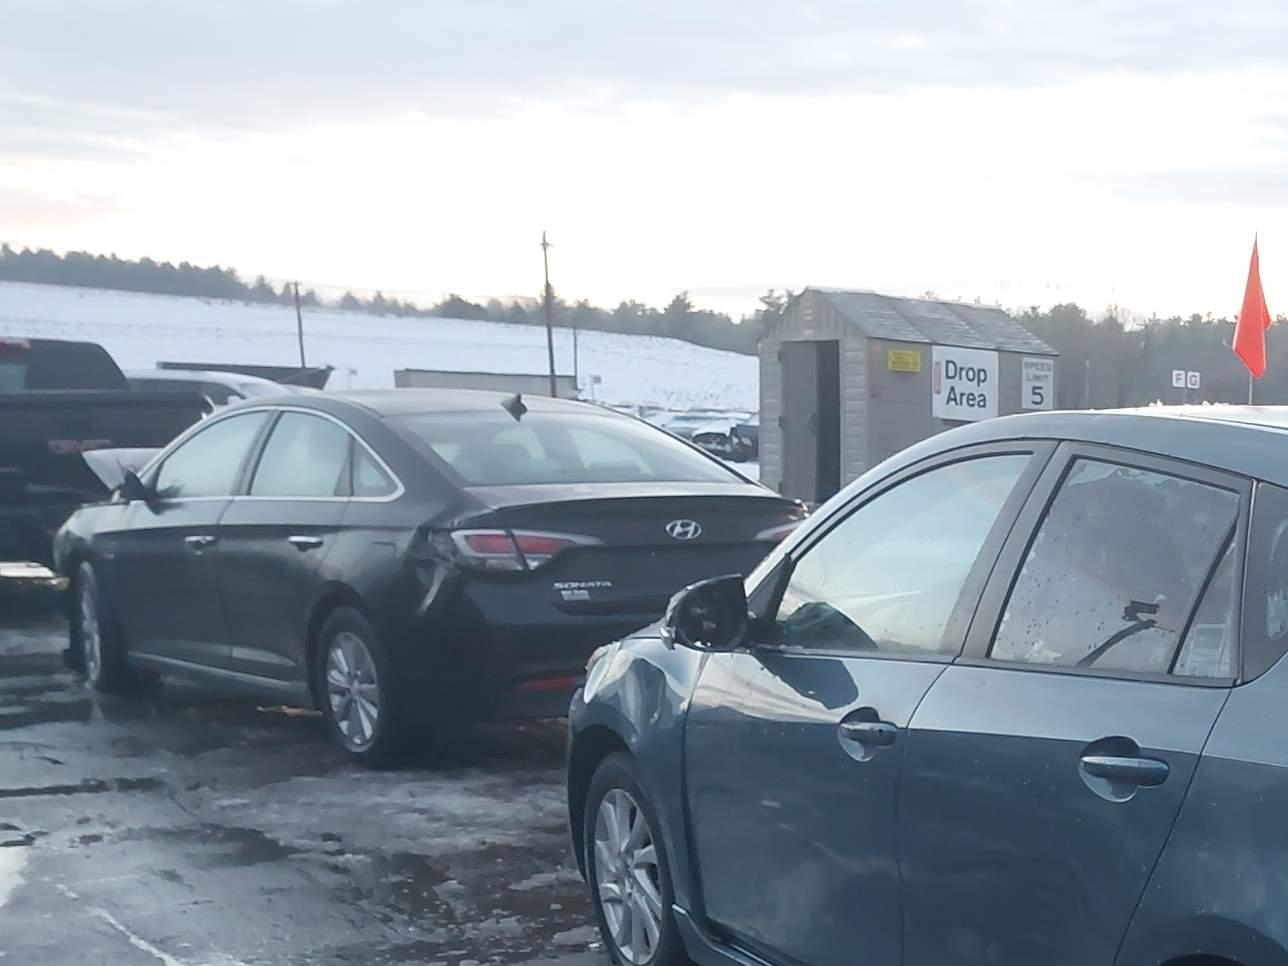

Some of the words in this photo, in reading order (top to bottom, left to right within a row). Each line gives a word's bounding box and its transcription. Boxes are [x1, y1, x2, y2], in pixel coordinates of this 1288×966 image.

[945, 360, 987, 387] Drop
[946, 386, 986, 408] Area
[1031, 386, 1044, 405] 5
